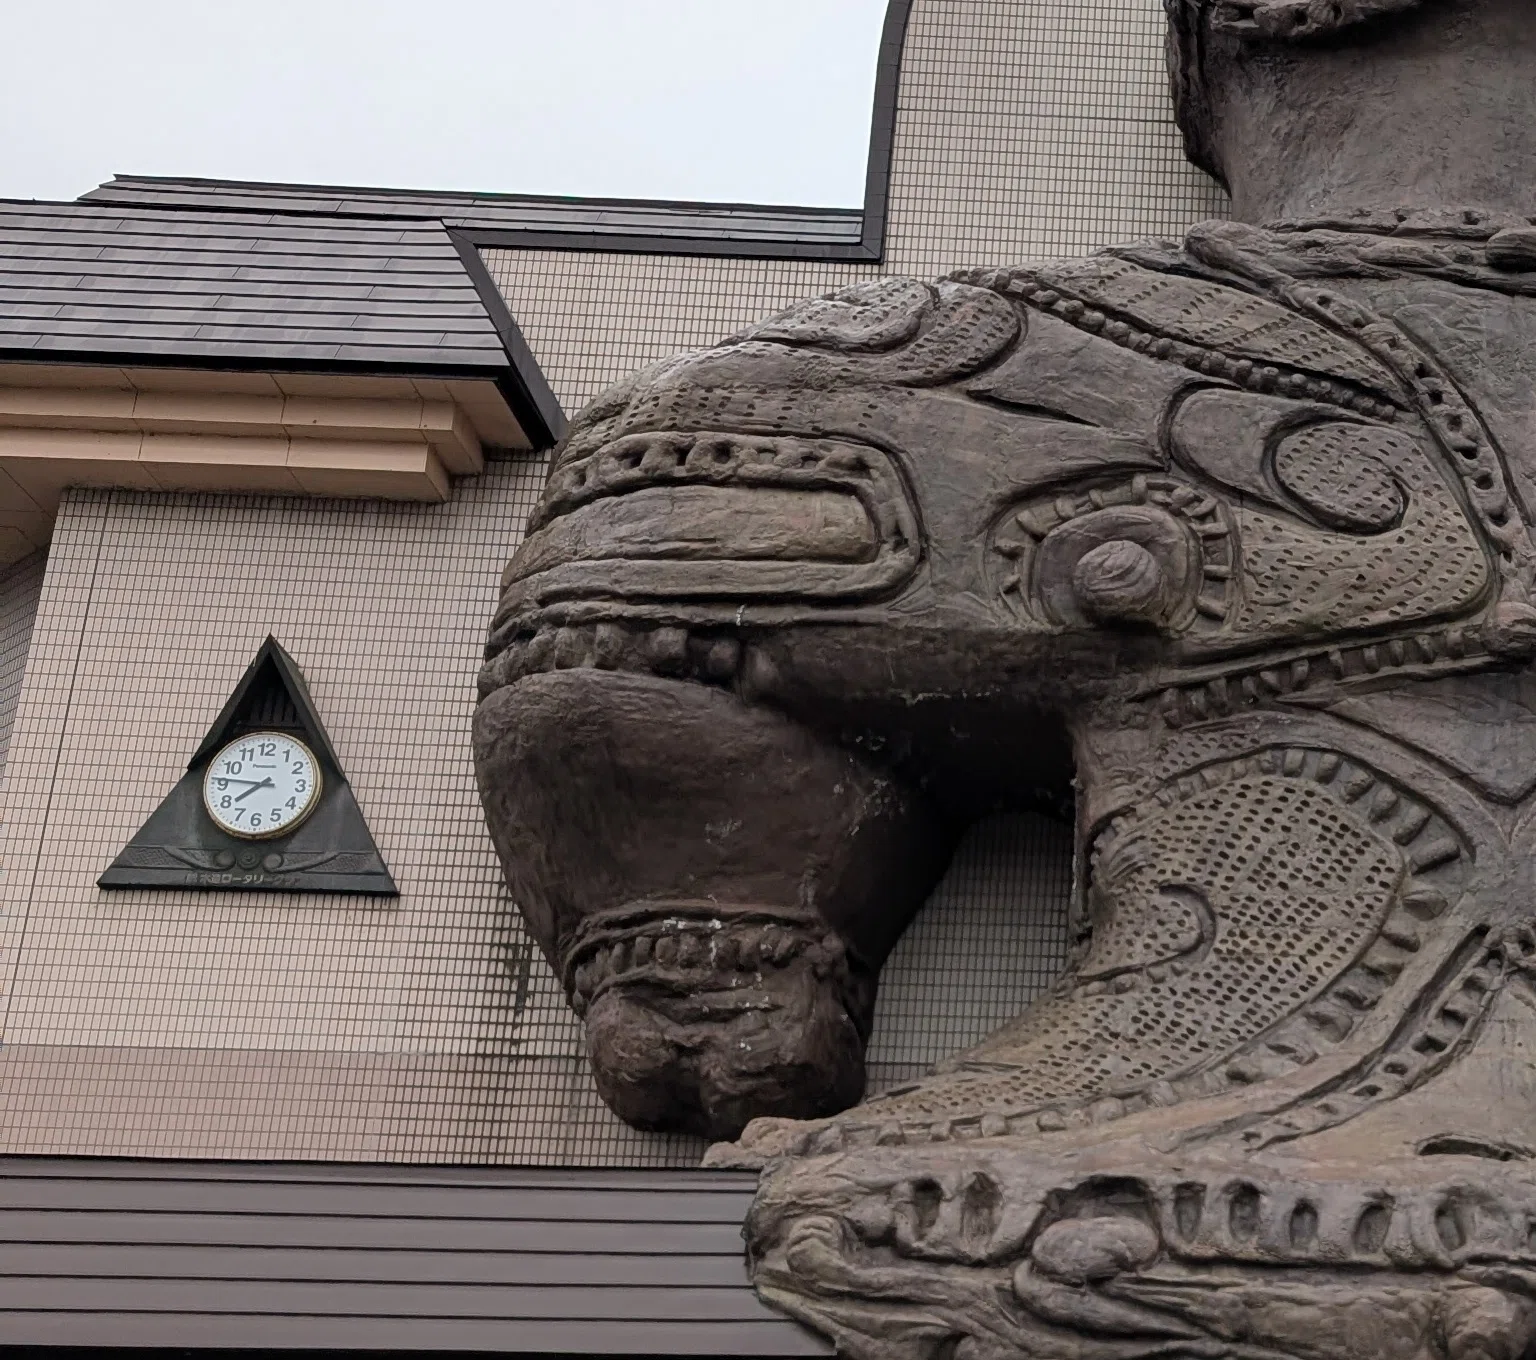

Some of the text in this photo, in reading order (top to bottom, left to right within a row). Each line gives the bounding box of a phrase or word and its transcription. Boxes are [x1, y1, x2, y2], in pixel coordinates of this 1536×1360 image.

[239, 748, 255, 761] 11
[258, 743, 277, 756] 12
[282, 749, 291, 763] 1
[223, 761, 243, 775] 10
[291, 761, 304, 775] 2
[217, 778, 229, 791] 9
[294, 779, 307, 793] 3
[220, 795, 232, 809] 8
[284, 796, 297, 810] 4
[234, 808, 247, 822] 7
[250, 813, 262, 827] 6
[269, 808, 282, 822] 5
